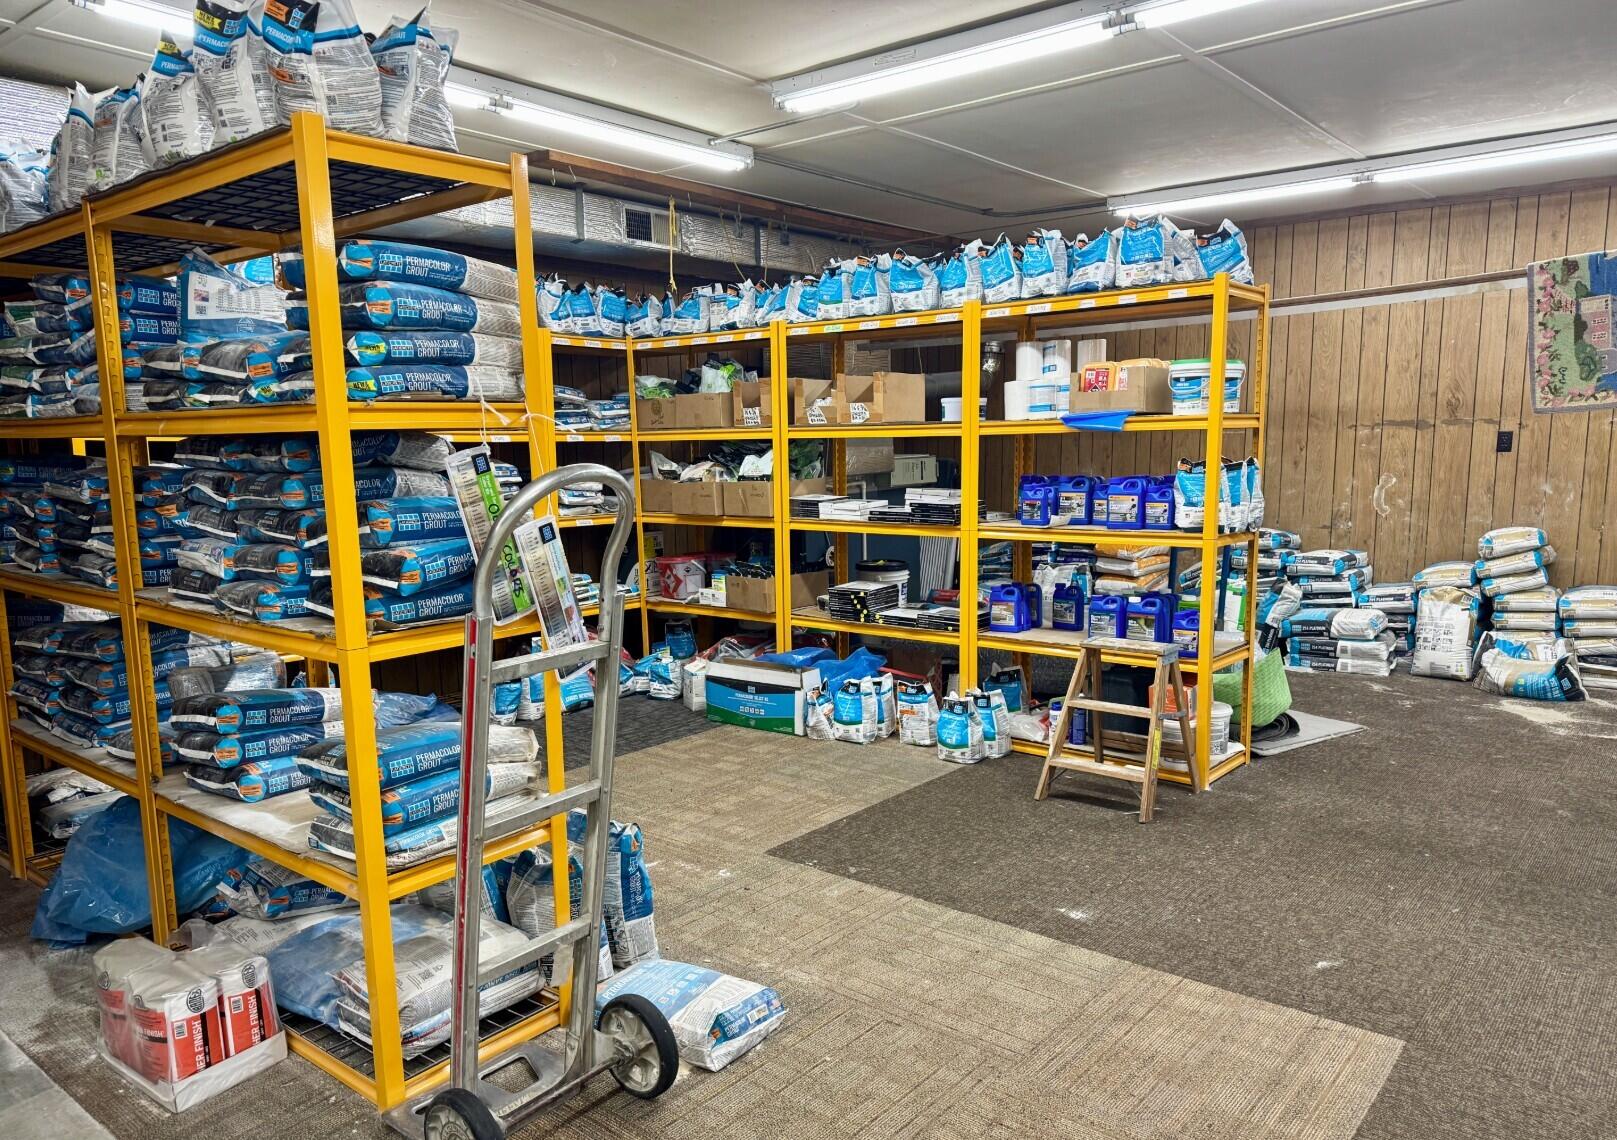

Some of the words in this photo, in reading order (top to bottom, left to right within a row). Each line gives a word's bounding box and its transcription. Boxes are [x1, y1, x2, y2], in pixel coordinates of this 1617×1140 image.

[405, 255, 451, 272] PERMACOLOR
[405, 266, 429, 277] GROUT
[422, 308, 444, 320] GROUT
[414, 339, 460, 348] PERMACOLOR
[417, 347, 441, 357] GROUT
[405, 372, 453, 383] PERMACOLOR
[408, 381, 432, 391] GROUT
[424, 519, 447, 530] GROUT
[417, 593, 464, 609] PERMACOLOR
[419, 605, 442, 617] GROUT
[269, 706, 310, 716] PERMACOLOR
[269, 714, 290, 724] GROUT
[269, 743, 290, 754] GROUT
[416, 744, 461, 763] PERMACOLOR
[417, 758, 441, 772] GROUT
[291, 776, 311, 788] GROUT
[433, 799, 455, 813] GROUT
[247, 994, 259, 1026] FINISH
[191, 1020, 204, 1053] FINISH
